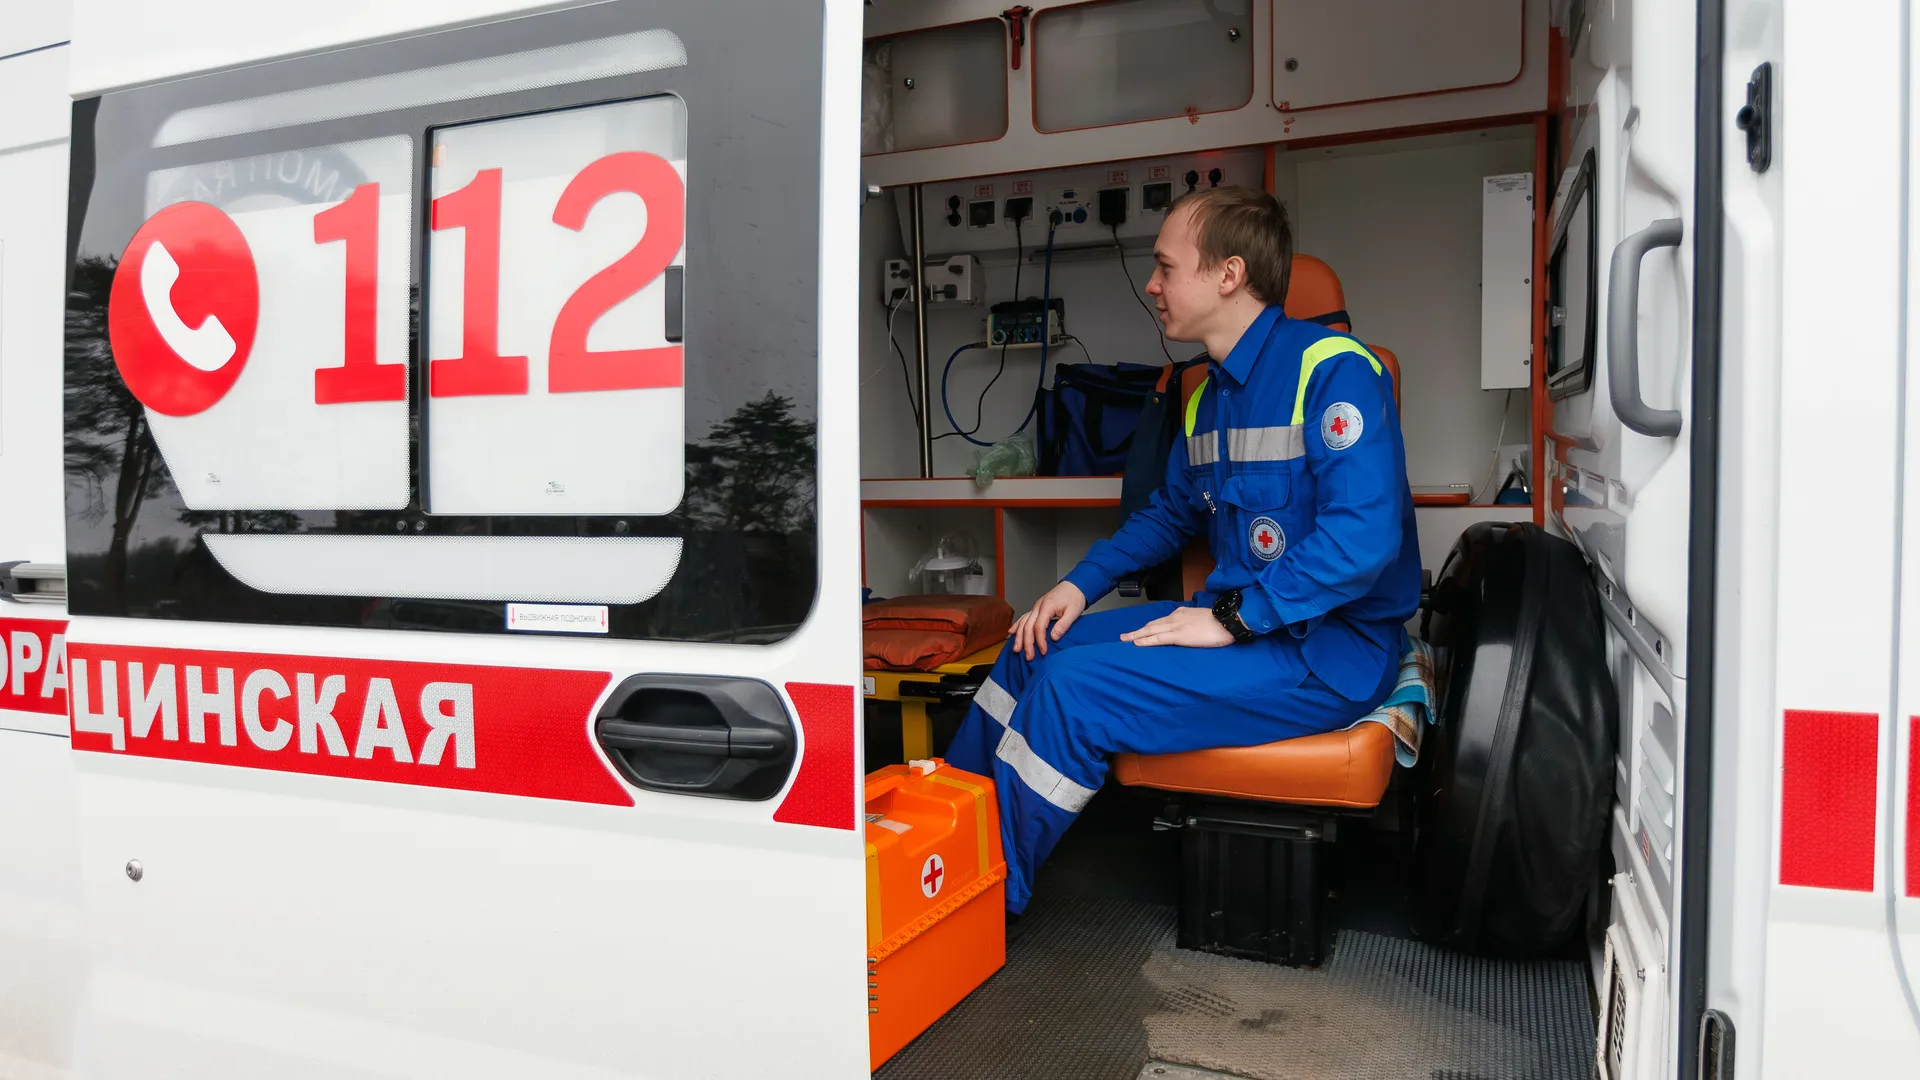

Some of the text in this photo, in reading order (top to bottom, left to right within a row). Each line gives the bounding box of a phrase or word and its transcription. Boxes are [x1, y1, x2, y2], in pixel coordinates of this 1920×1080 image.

[313, 151, 685, 405] 112
[519, 613, 597, 623] ВЫДВИЖНАЯ ПОДНОЖКА
[0, 630, 477, 770] РА ЦИНСКАЯ
